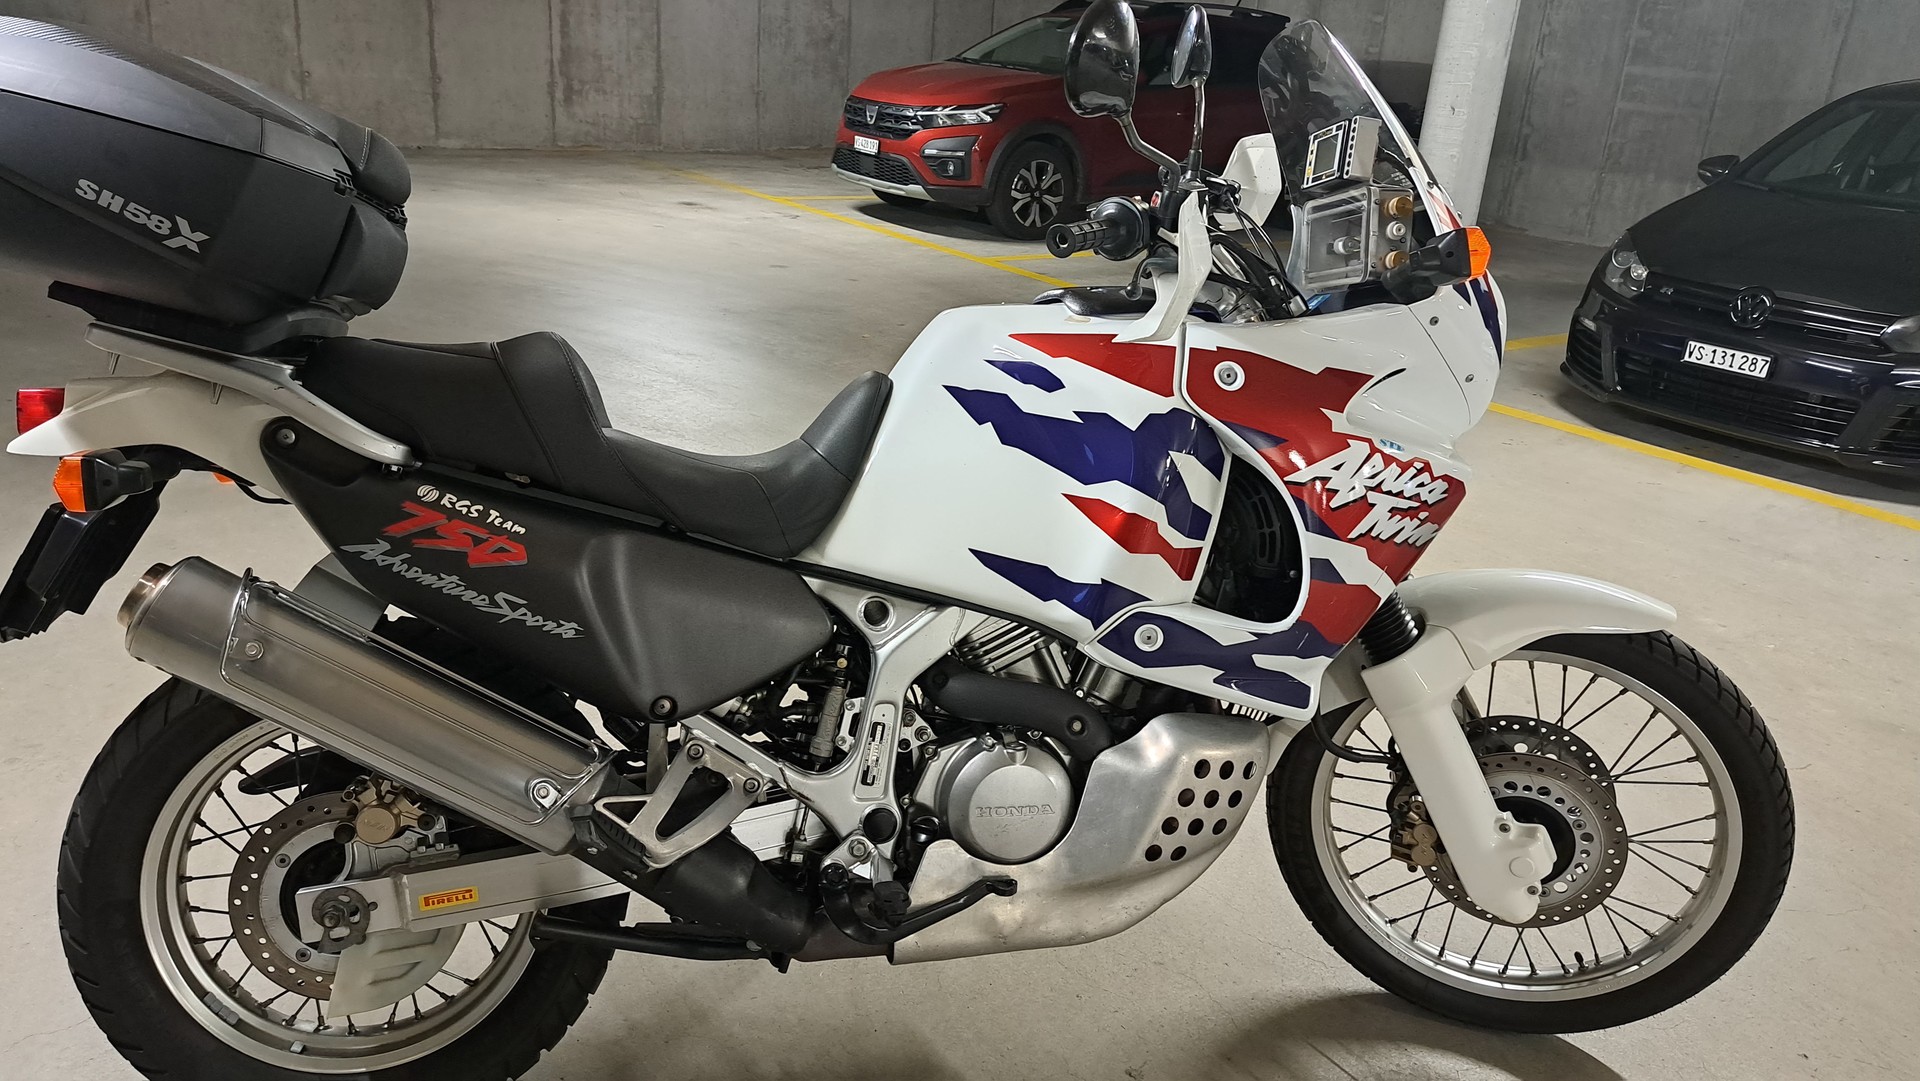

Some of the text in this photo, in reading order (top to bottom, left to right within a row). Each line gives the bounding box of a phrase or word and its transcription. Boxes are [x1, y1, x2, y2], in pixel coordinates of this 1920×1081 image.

[75, 178, 210, 254] SH58X
[1283, 439, 1450, 508] Africa
[381, 500, 528, 568] 750
[440, 492, 527, 536] RGS Team
[1347, 491, 1440, 547] Twin
[976, 803, 1056, 818] HONDA
[423, 888, 473, 907] PIRELLI
